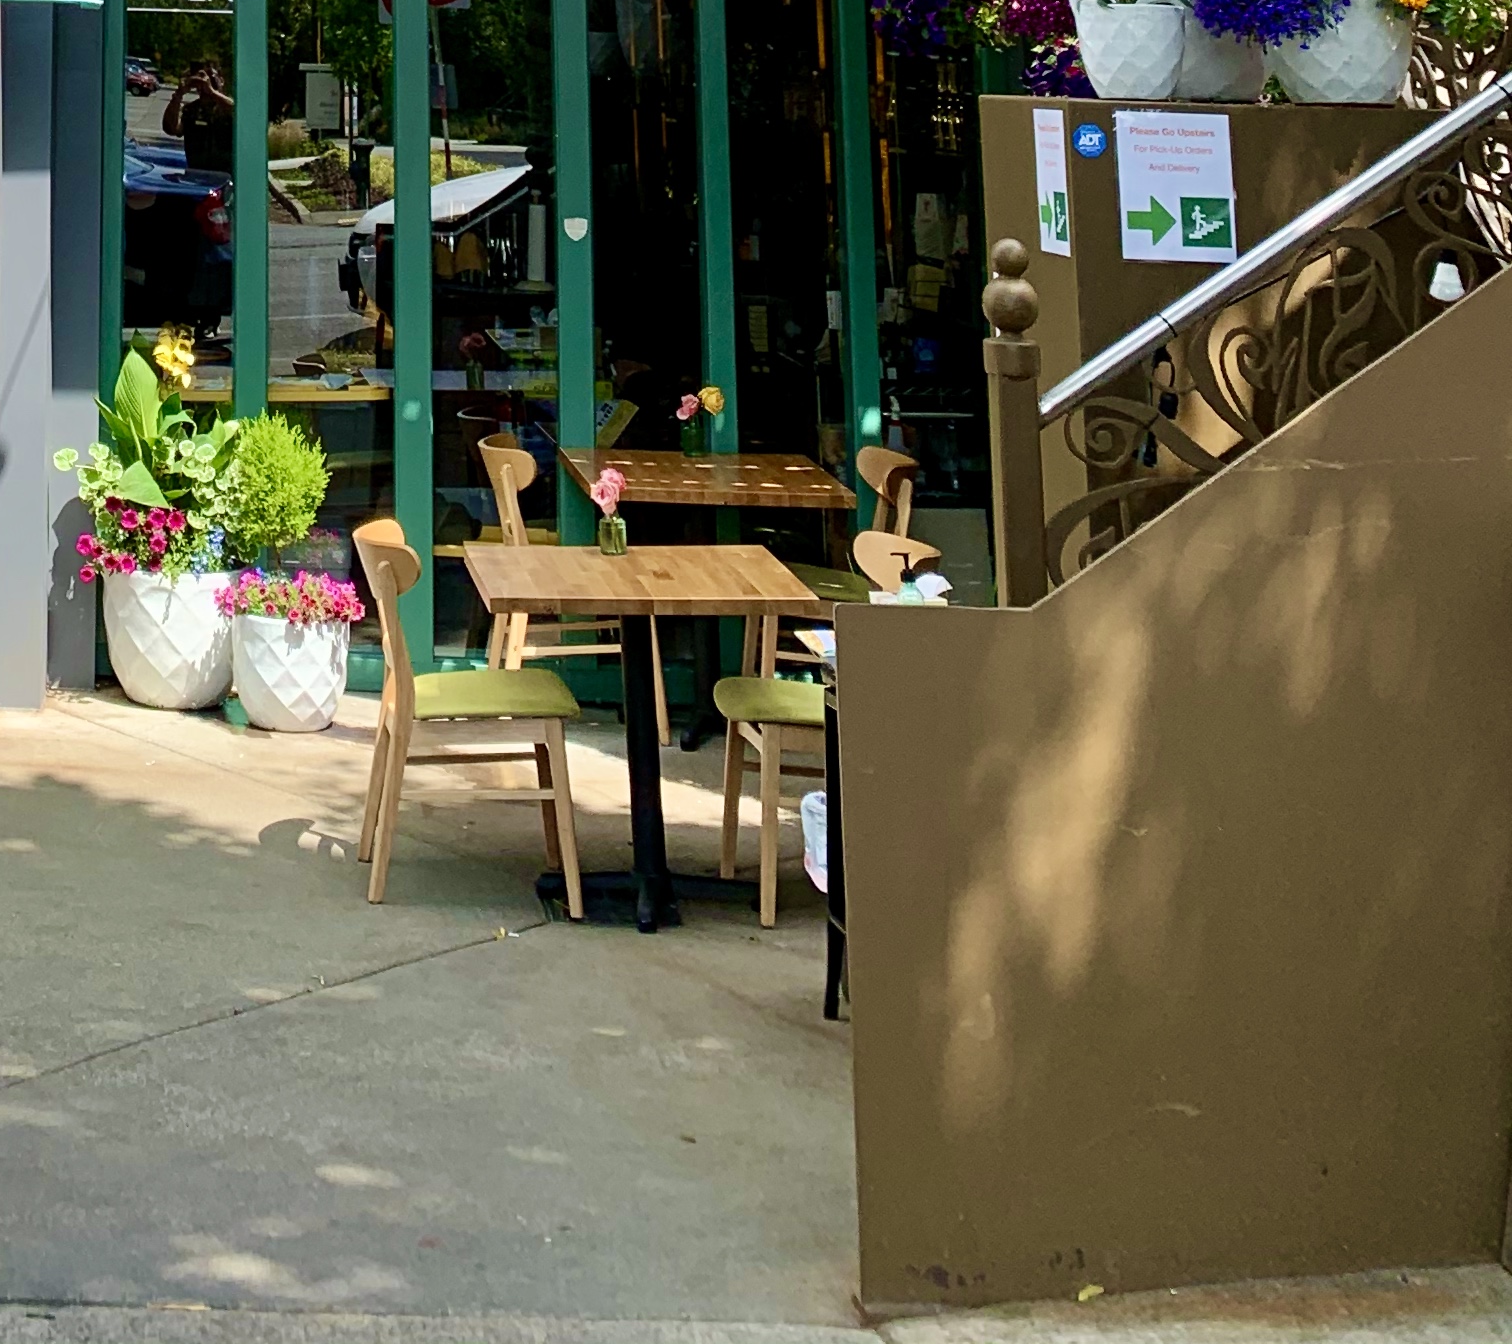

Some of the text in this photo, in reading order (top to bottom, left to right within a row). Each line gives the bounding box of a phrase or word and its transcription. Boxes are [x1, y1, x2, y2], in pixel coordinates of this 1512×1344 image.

[1162, 128, 1175, 136] Go
[1079, 133, 1101, 145] ADT
[1134, 144, 1147, 152] For
